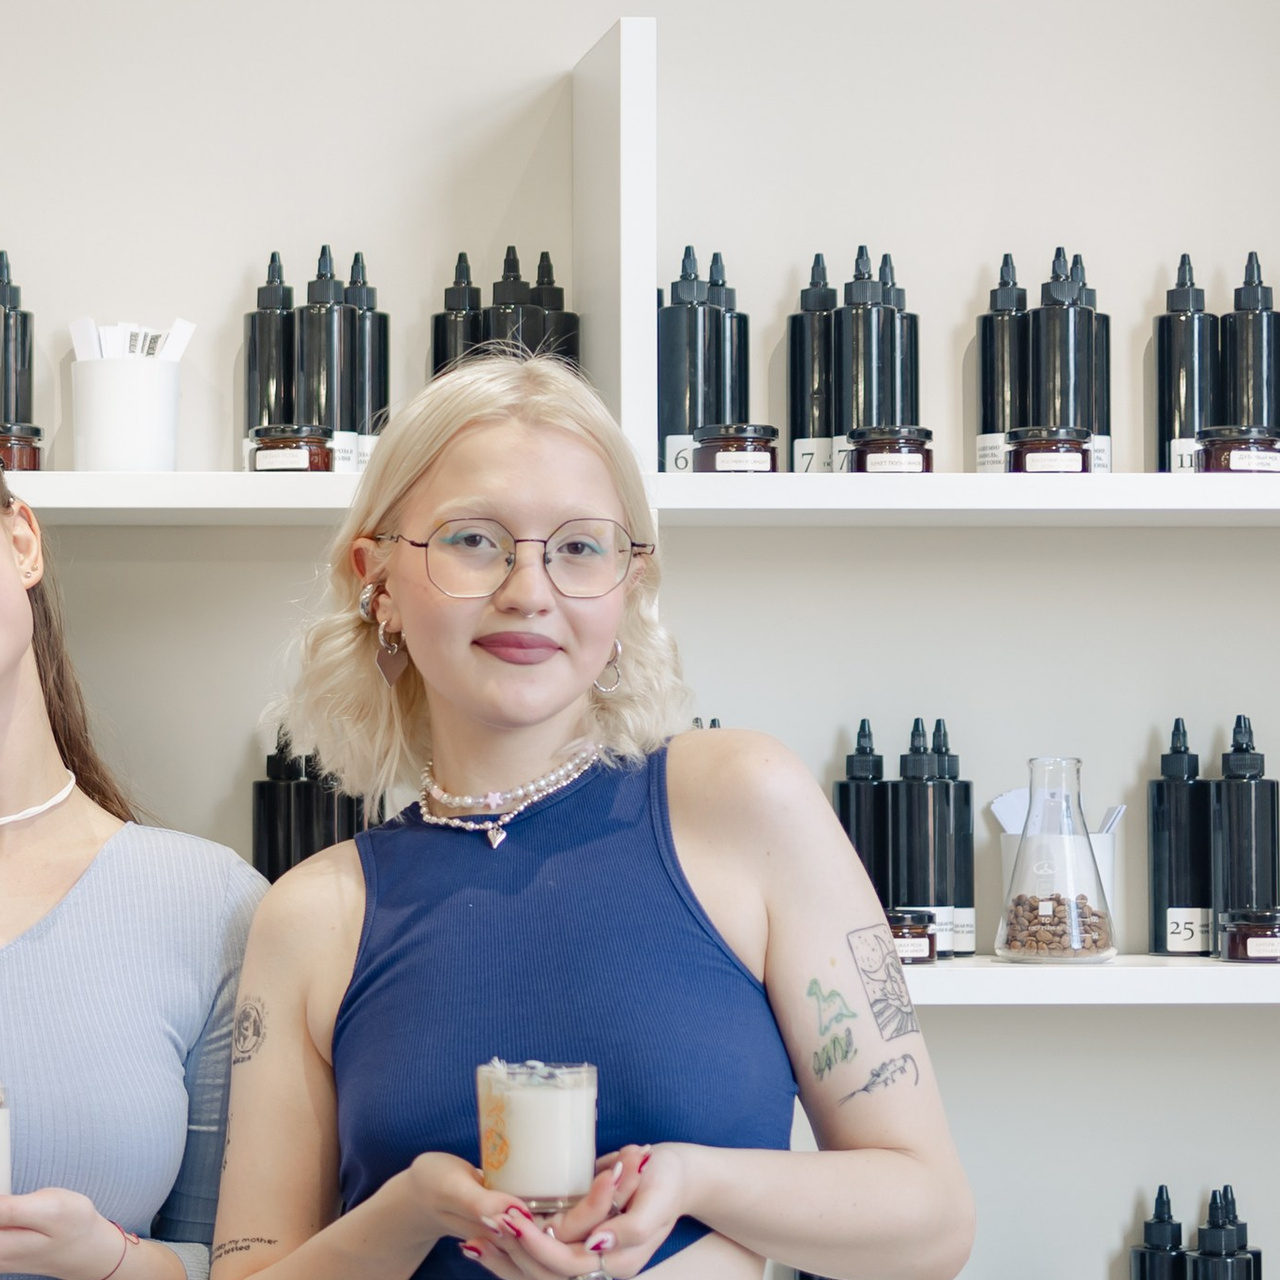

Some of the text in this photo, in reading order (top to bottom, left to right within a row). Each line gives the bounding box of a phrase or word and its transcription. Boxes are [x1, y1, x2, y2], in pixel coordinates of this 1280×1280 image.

[675, 448, 689, 470] 6
[802, 453, 815, 472] 7
[1170, 921, 1195, 941] 25
[241, 1237, 278, 1245] mother
